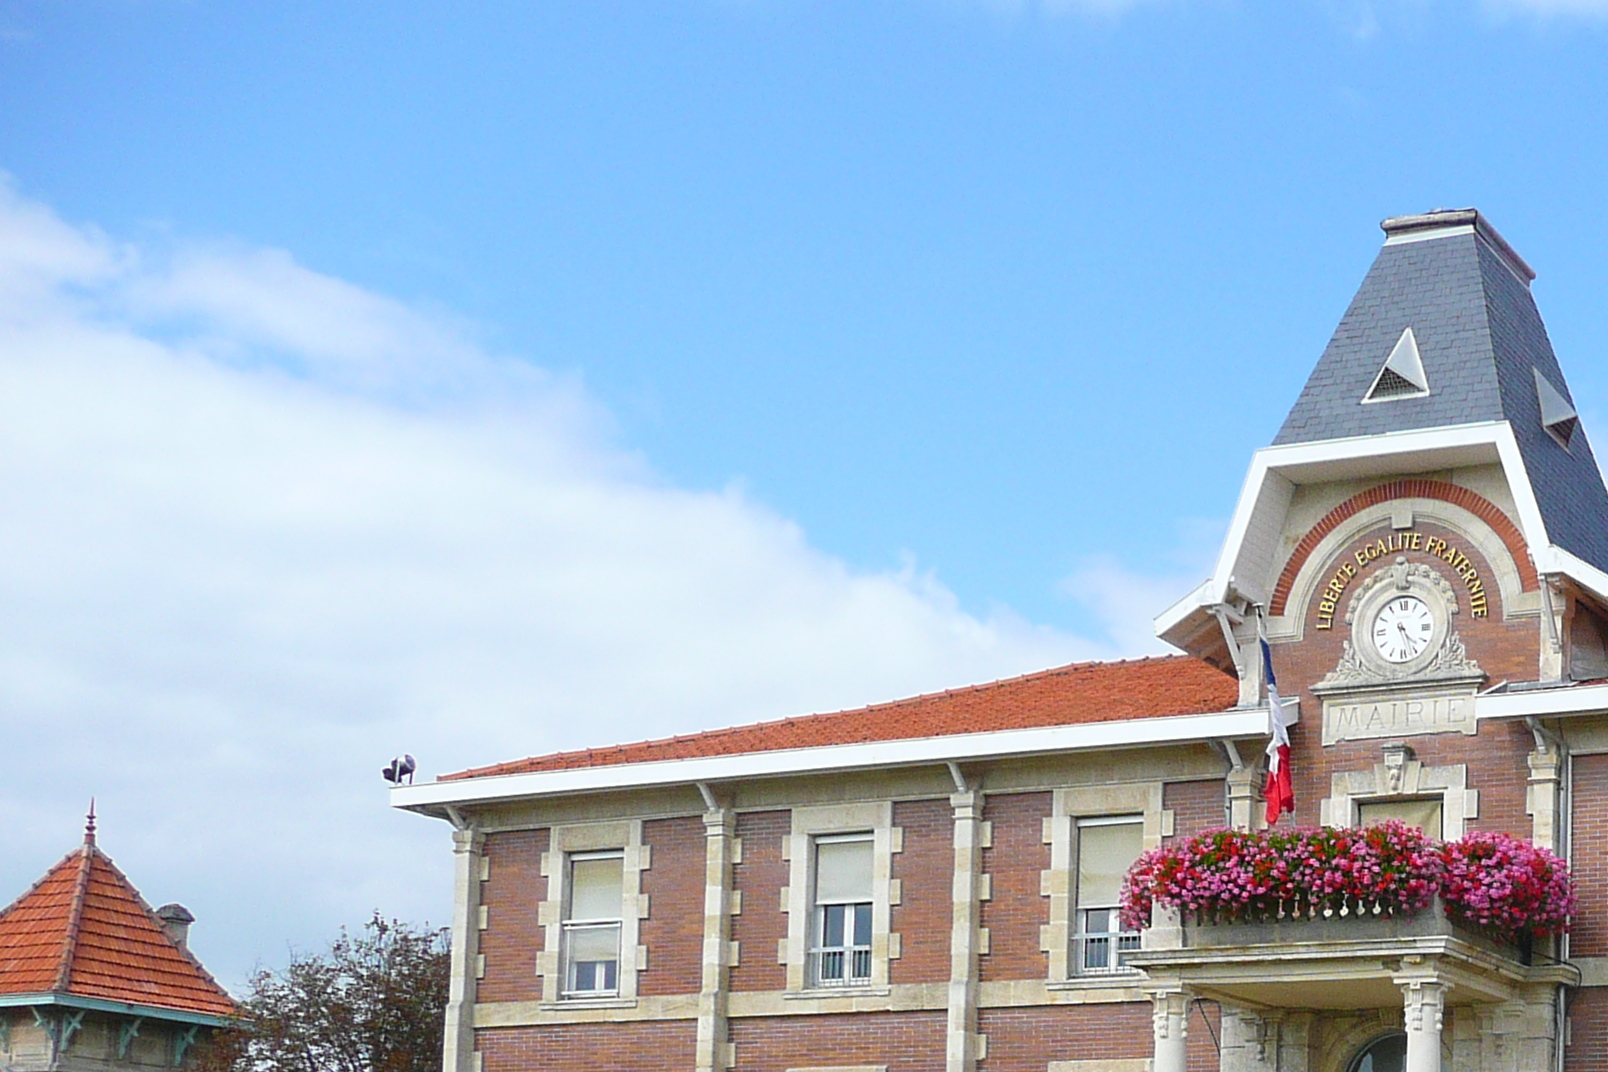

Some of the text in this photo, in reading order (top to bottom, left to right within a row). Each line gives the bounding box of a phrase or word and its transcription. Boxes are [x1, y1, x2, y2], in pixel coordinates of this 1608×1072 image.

[1316, 532, 1487, 630] LIBERTE EGALITE FRATERNITE
[1336, 698, 1467, 732] MAIRIE
